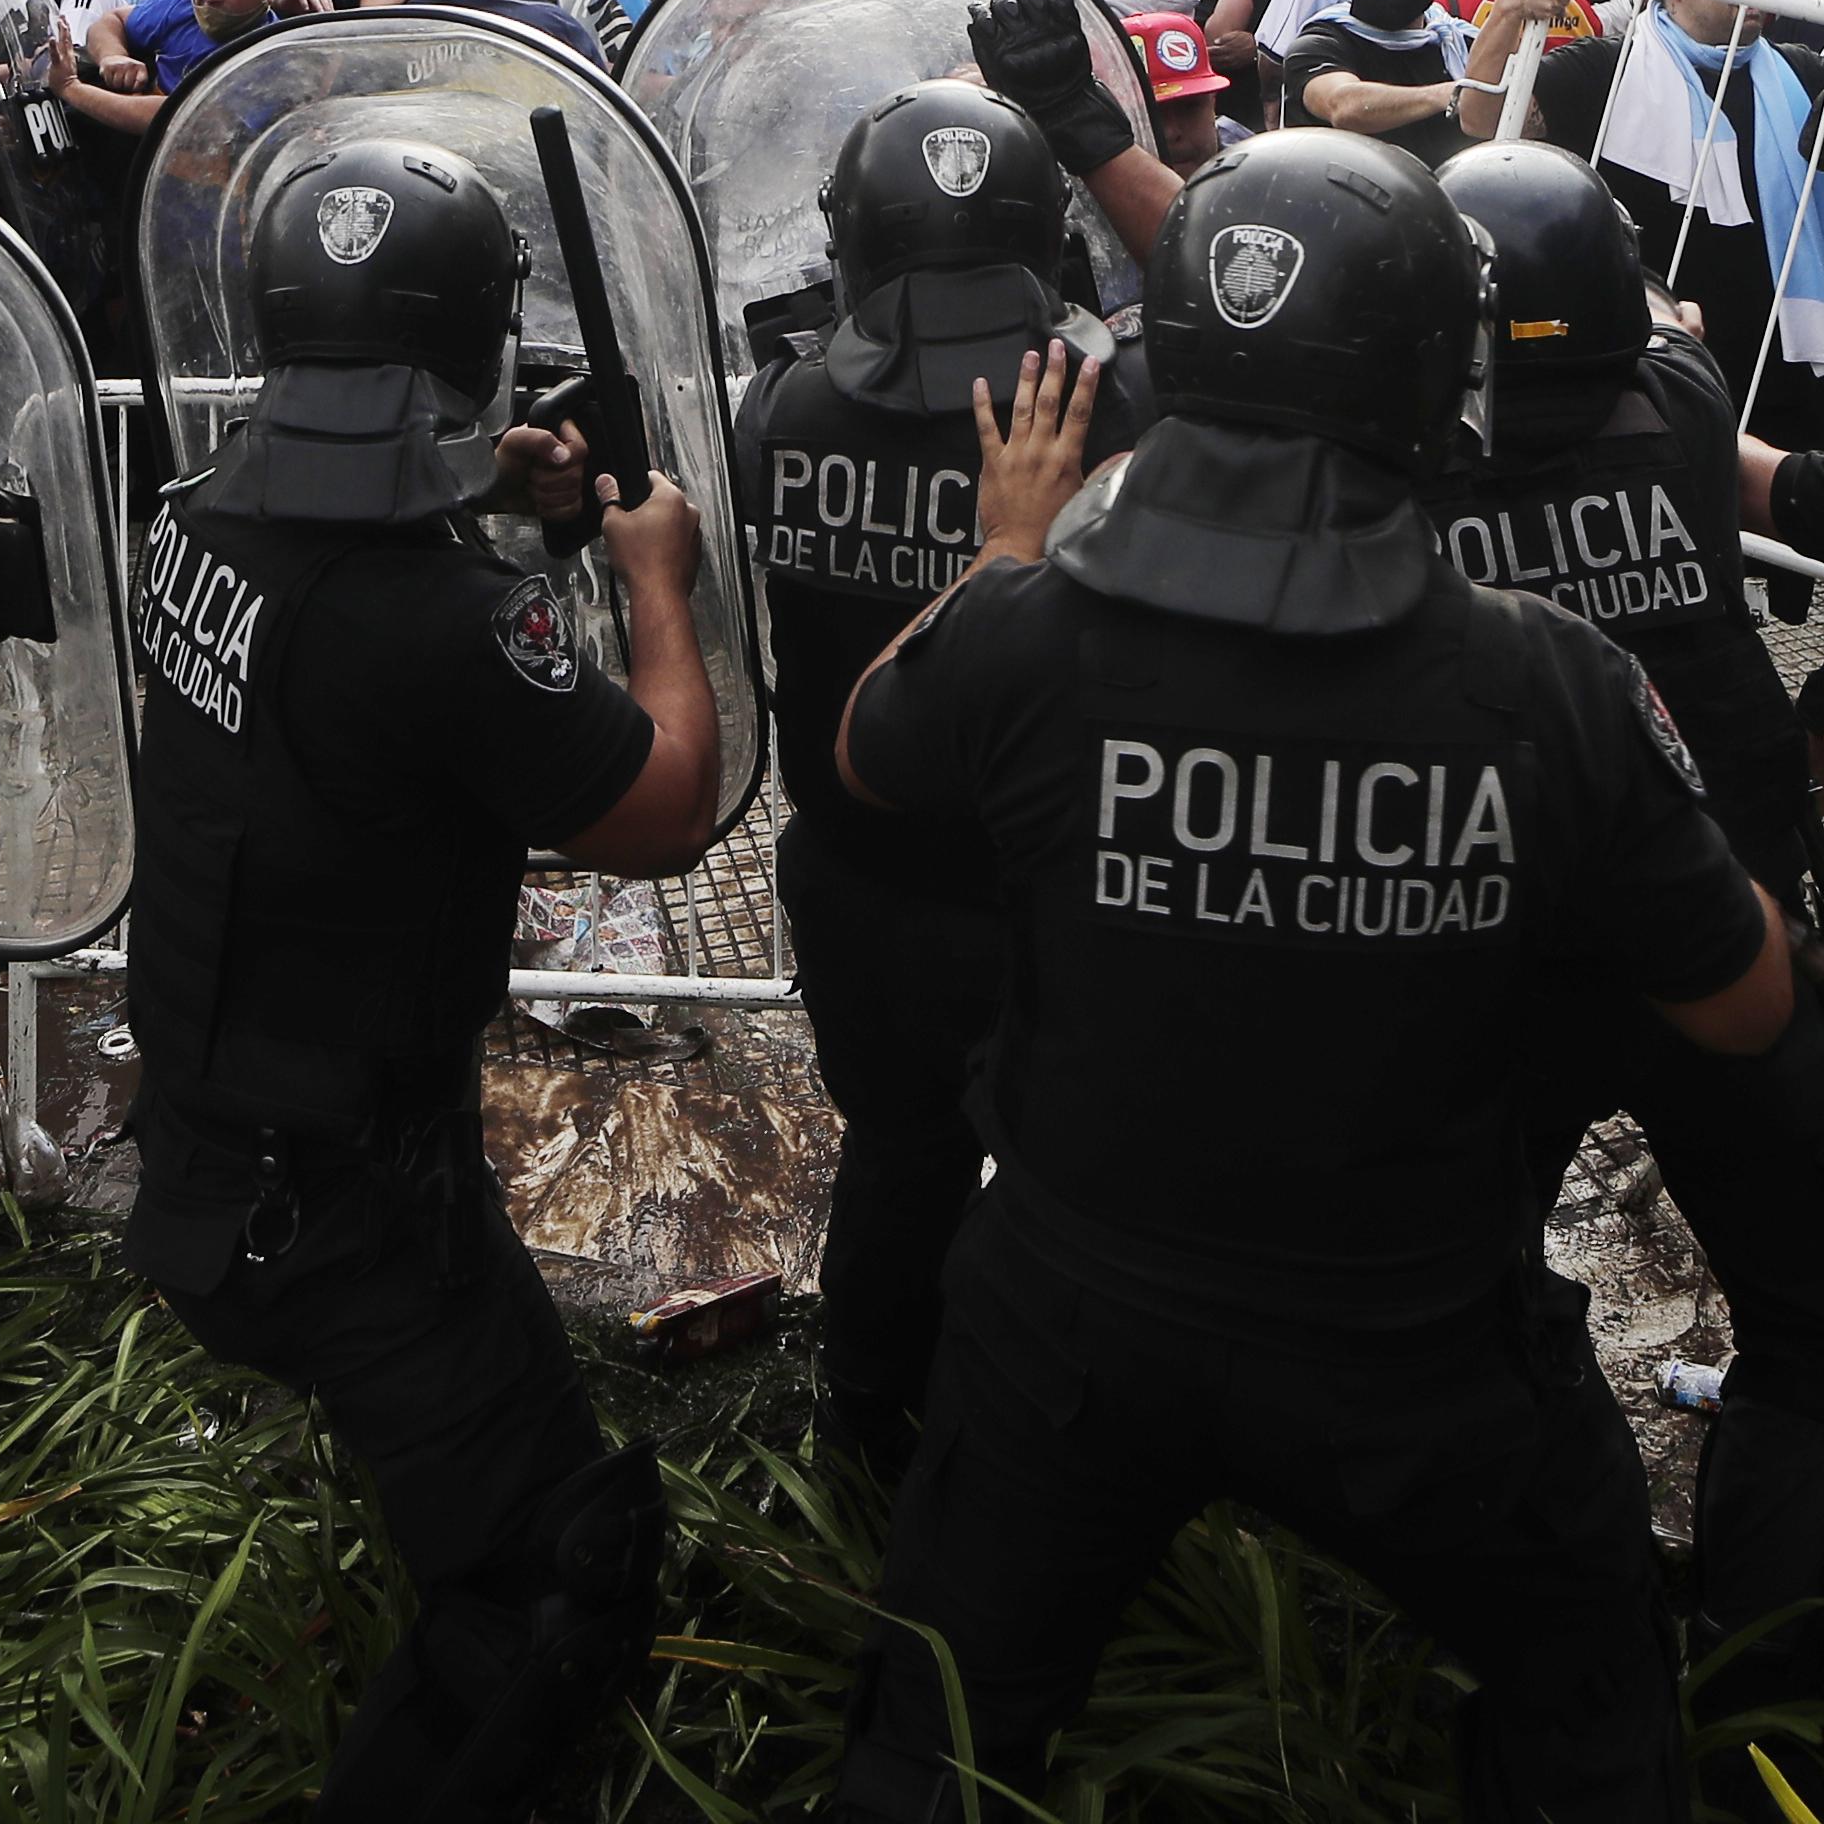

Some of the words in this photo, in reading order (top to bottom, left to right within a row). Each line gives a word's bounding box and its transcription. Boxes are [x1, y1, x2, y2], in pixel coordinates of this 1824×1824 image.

[936, 129, 976, 143] POLICIA
[1232, 229, 1284, 250] POLICIA
[769, 524, 817, 572] DE
[829, 534, 878, 584] LA
[1435, 484, 1697, 583] OLICIA
[149, 500, 265, 682] POLICIA
[1550, 561, 1709, 622] CIUDAD
[162, 630, 244, 734] CIUDAD
[1097, 738, 1516, 867] POLICIA
[1095, 850, 1174, 915] DE
[1195, 863, 1275, 928] LA
[1297, 874, 1511, 937] CIUDAD
